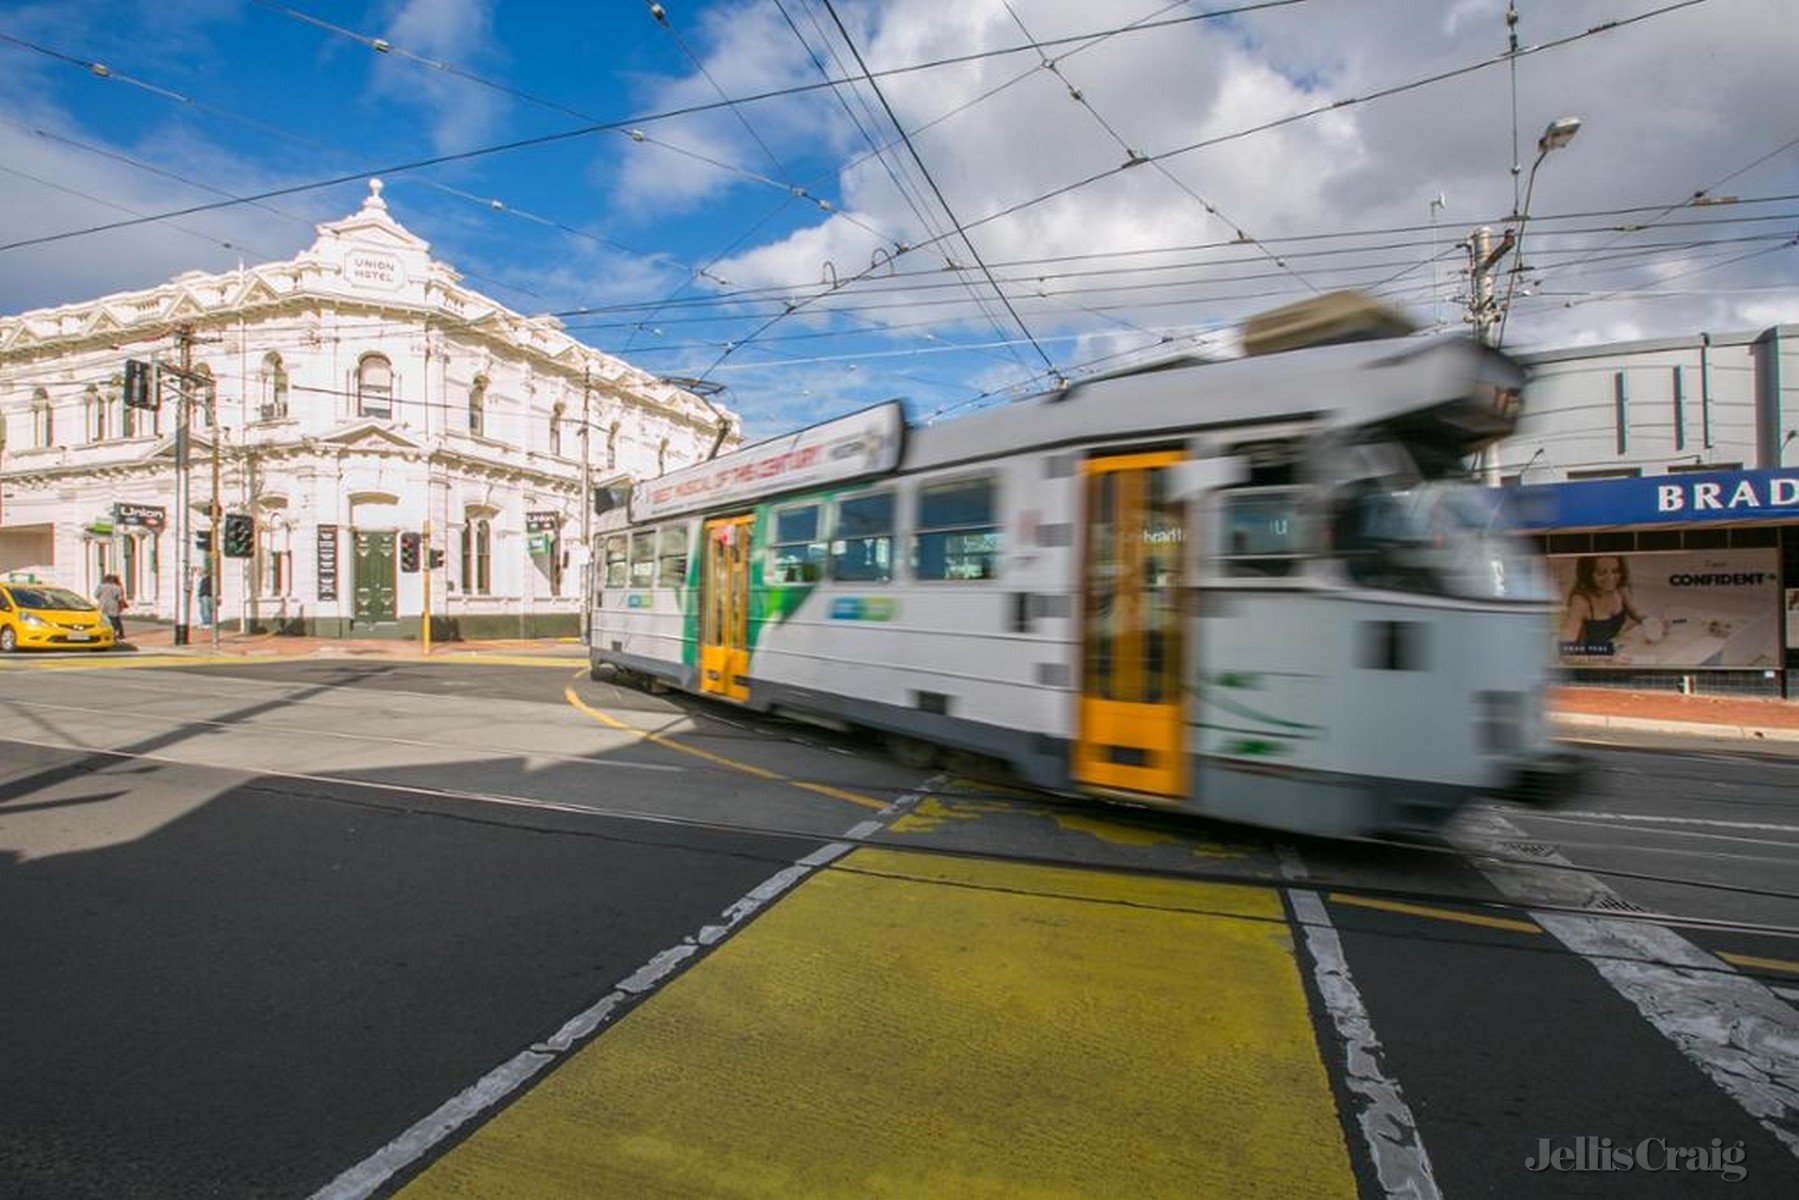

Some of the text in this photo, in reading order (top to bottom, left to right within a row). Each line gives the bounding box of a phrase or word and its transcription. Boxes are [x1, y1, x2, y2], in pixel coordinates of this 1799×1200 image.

[354, 258, 395, 272] UNION
[354, 269, 395, 283] HOTEL
[1657, 478, 1799, 512] BRAD
[120, 505, 164, 519] Union
[1669, 572, 1765, 586] CONFIDENT
